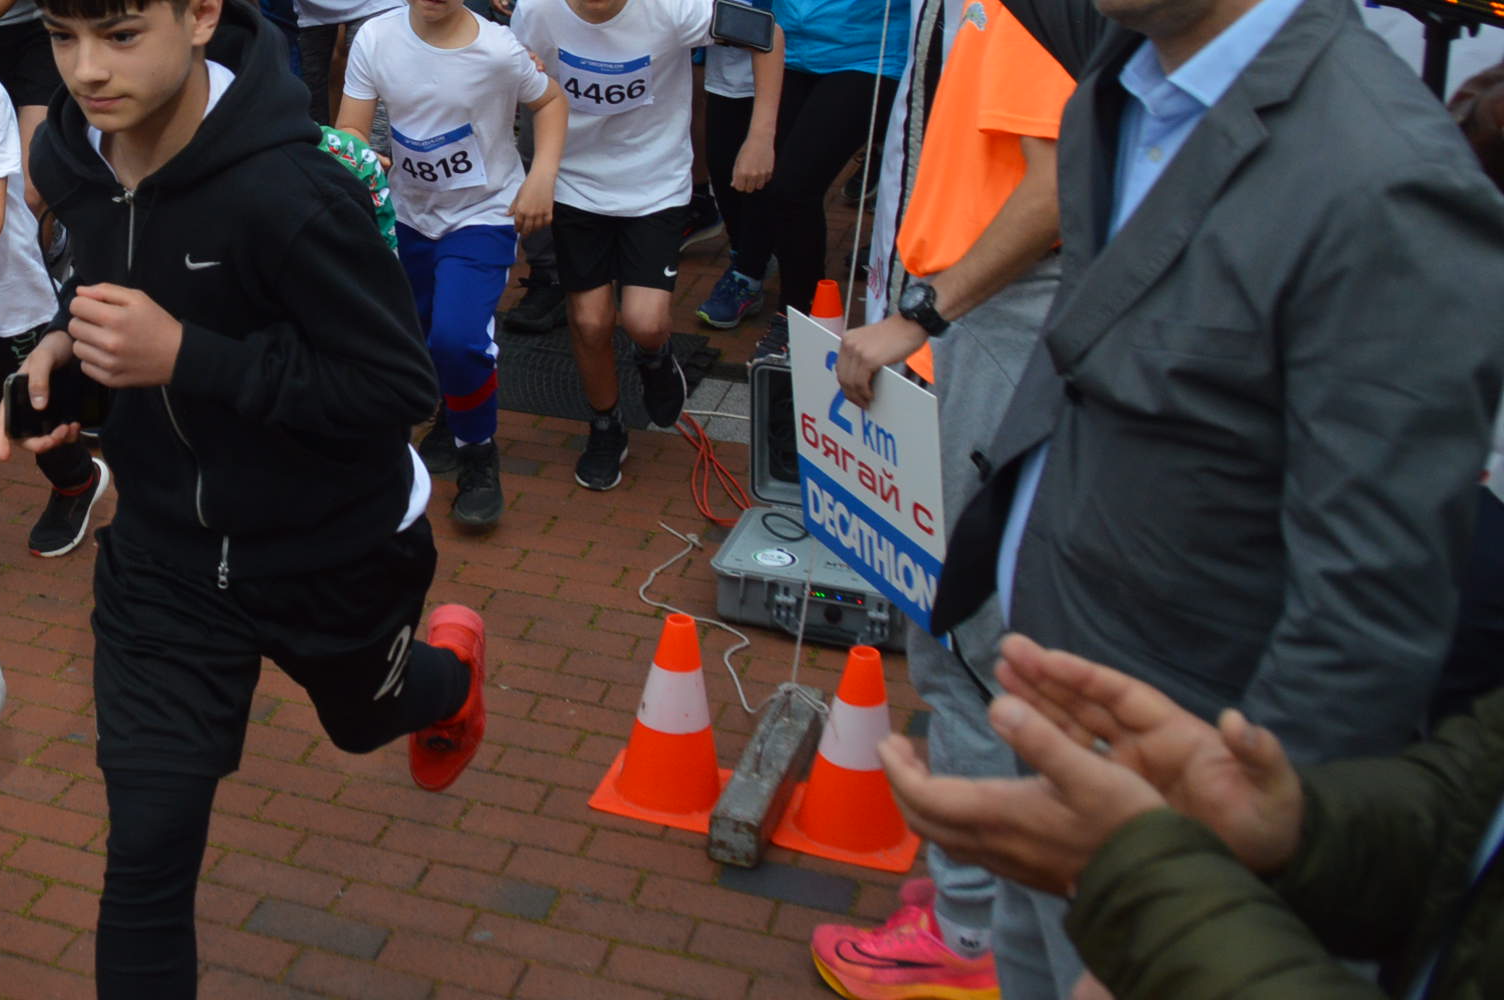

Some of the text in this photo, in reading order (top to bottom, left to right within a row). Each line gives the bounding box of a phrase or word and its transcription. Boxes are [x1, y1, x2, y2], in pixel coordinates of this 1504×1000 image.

[564, 77, 646, 104] 4466
[401, 150, 473, 182] 4818
[800, 413, 935, 537] бягай с
[806, 476, 937, 613] DECATHLON
